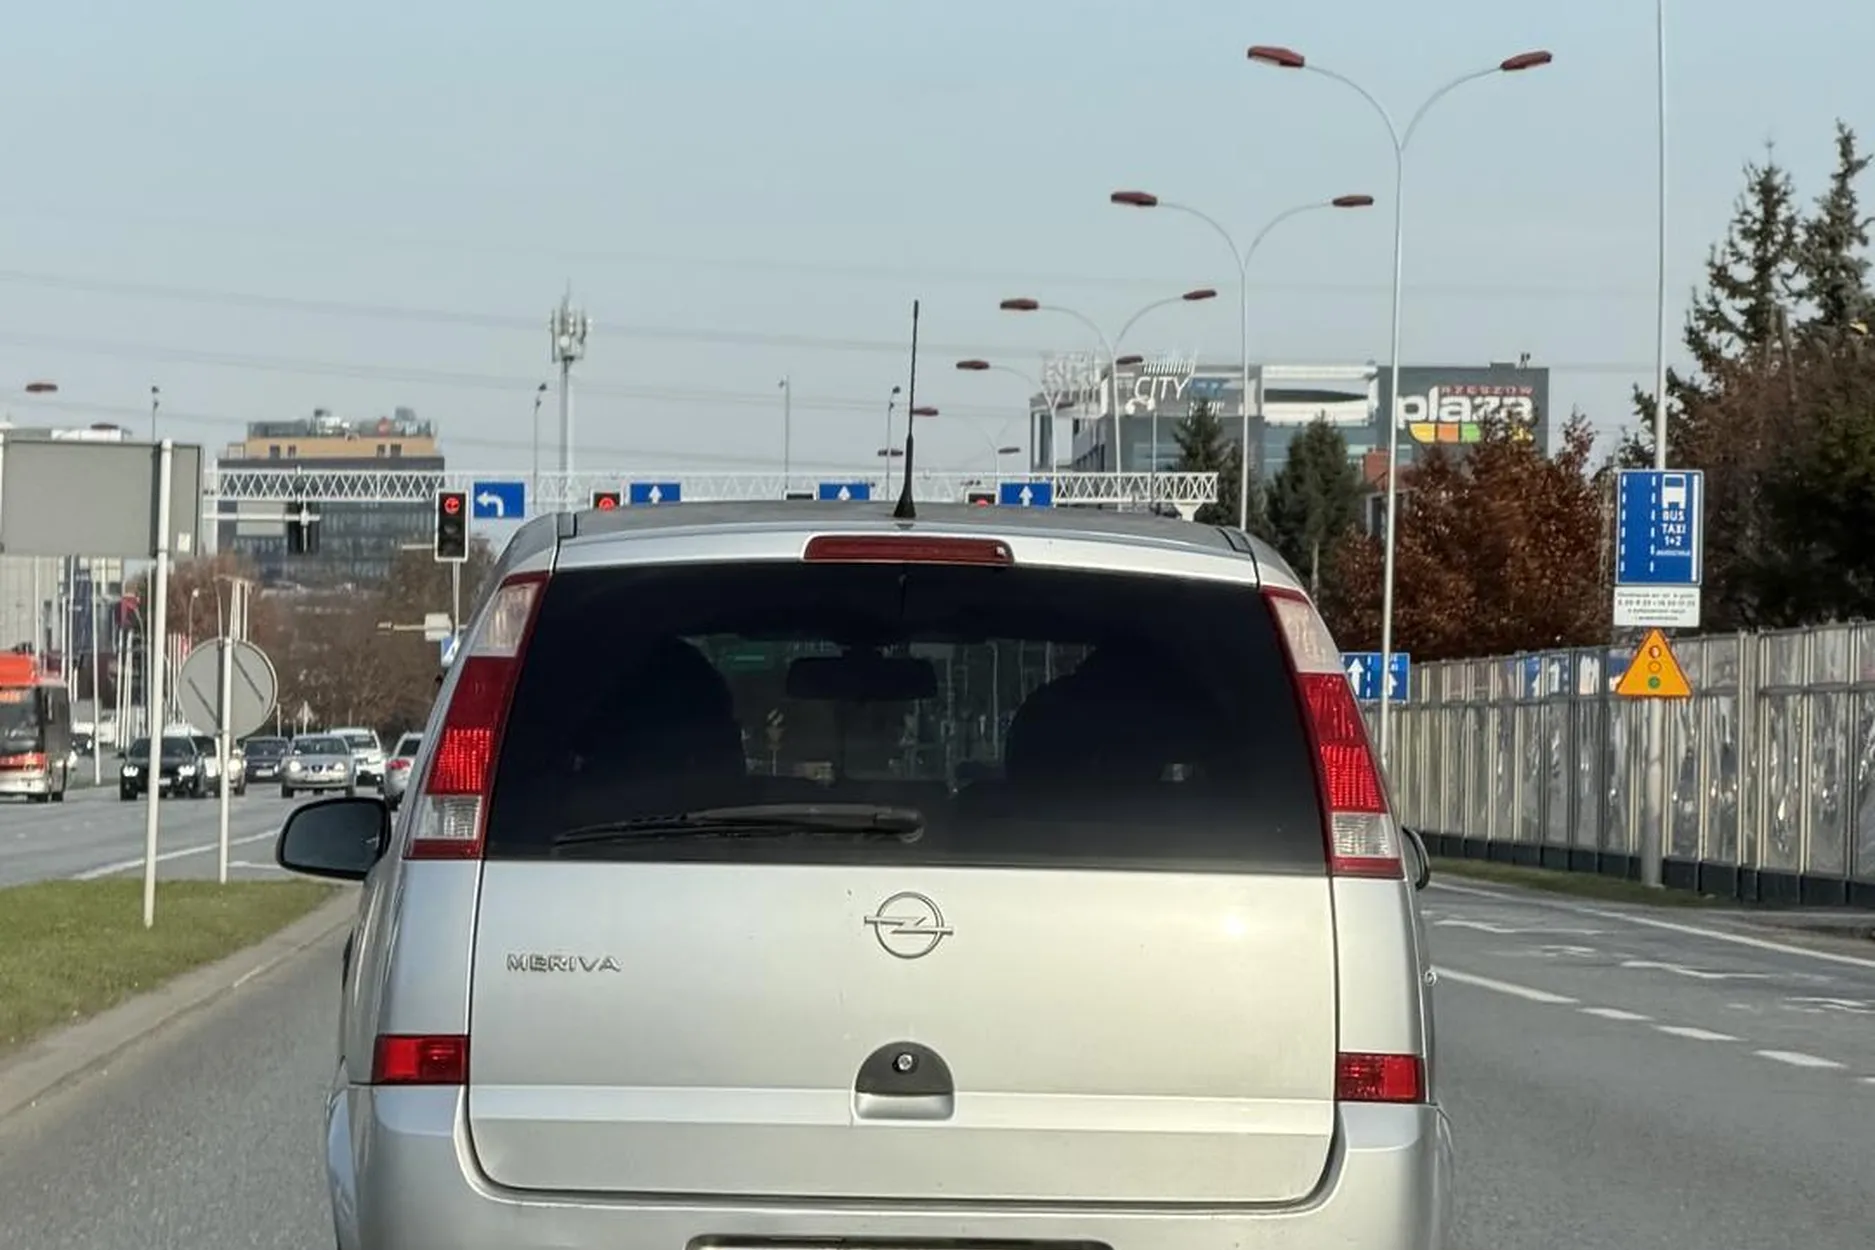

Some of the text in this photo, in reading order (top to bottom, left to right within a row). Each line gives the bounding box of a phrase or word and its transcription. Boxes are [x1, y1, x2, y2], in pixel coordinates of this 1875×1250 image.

[1135, 375, 1192, 401] CITY
[1396, 385, 1534, 430] plaza
[1662, 510, 1685, 521] BUS
[1662, 523, 1687, 534] TAXI
[506, 953, 622, 973] MERIVA
